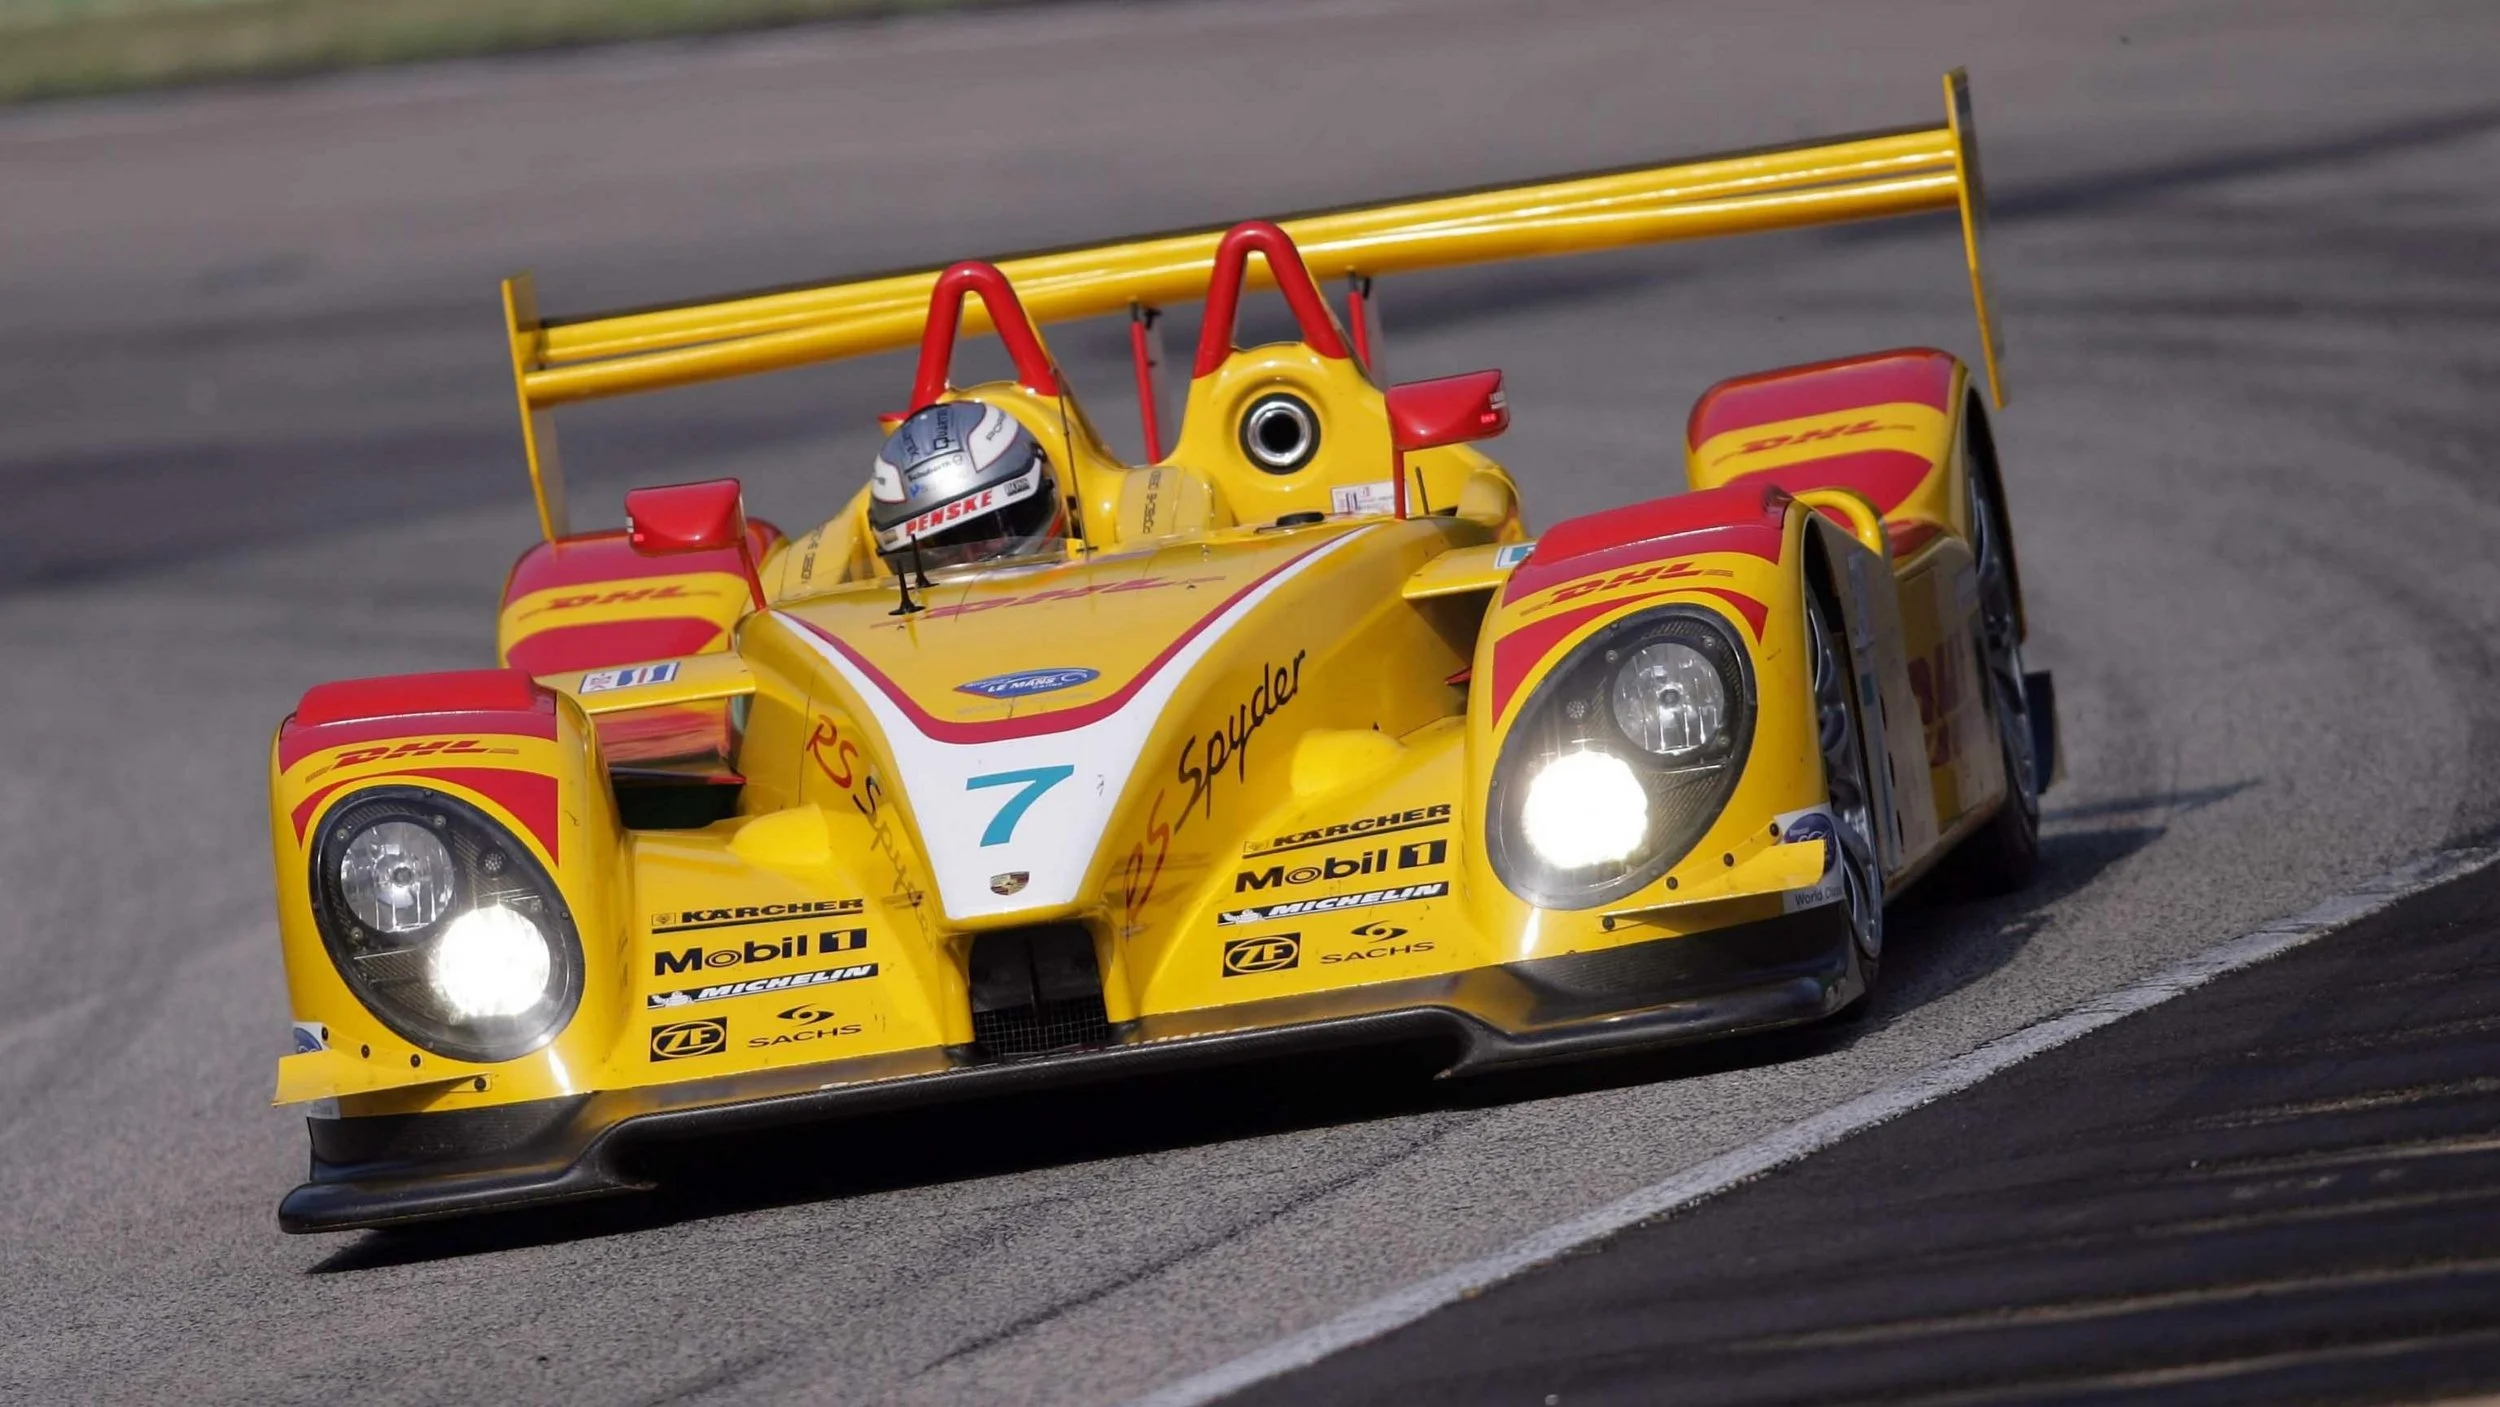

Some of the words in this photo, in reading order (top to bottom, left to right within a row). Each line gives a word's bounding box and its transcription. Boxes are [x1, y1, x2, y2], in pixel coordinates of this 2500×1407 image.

[1741, 419, 1878, 453] DHL
[906, 490, 993, 536] PENSKE
[548, 584, 686, 611] DHL
[1550, 562, 1703, 605] DHL
[988, 682, 1006, 693] LE
[1010, 676, 1056, 690] MANS
[331, 740, 489, 770] DHL
[806, 714, 858, 789] RS
[1174, 649, 1306, 836] Spyder
[966, 764, 1075, 847] 7
[1235, 849, 1388, 892] Mobil
[1268, 884, 1442, 916] MICHELIN
[654, 935, 807, 976] Mobil
[1321, 942, 1435, 964] SACHS
[698, 965, 872, 999] MICHELIN
[748, 1024, 862, 1048] SACHS
